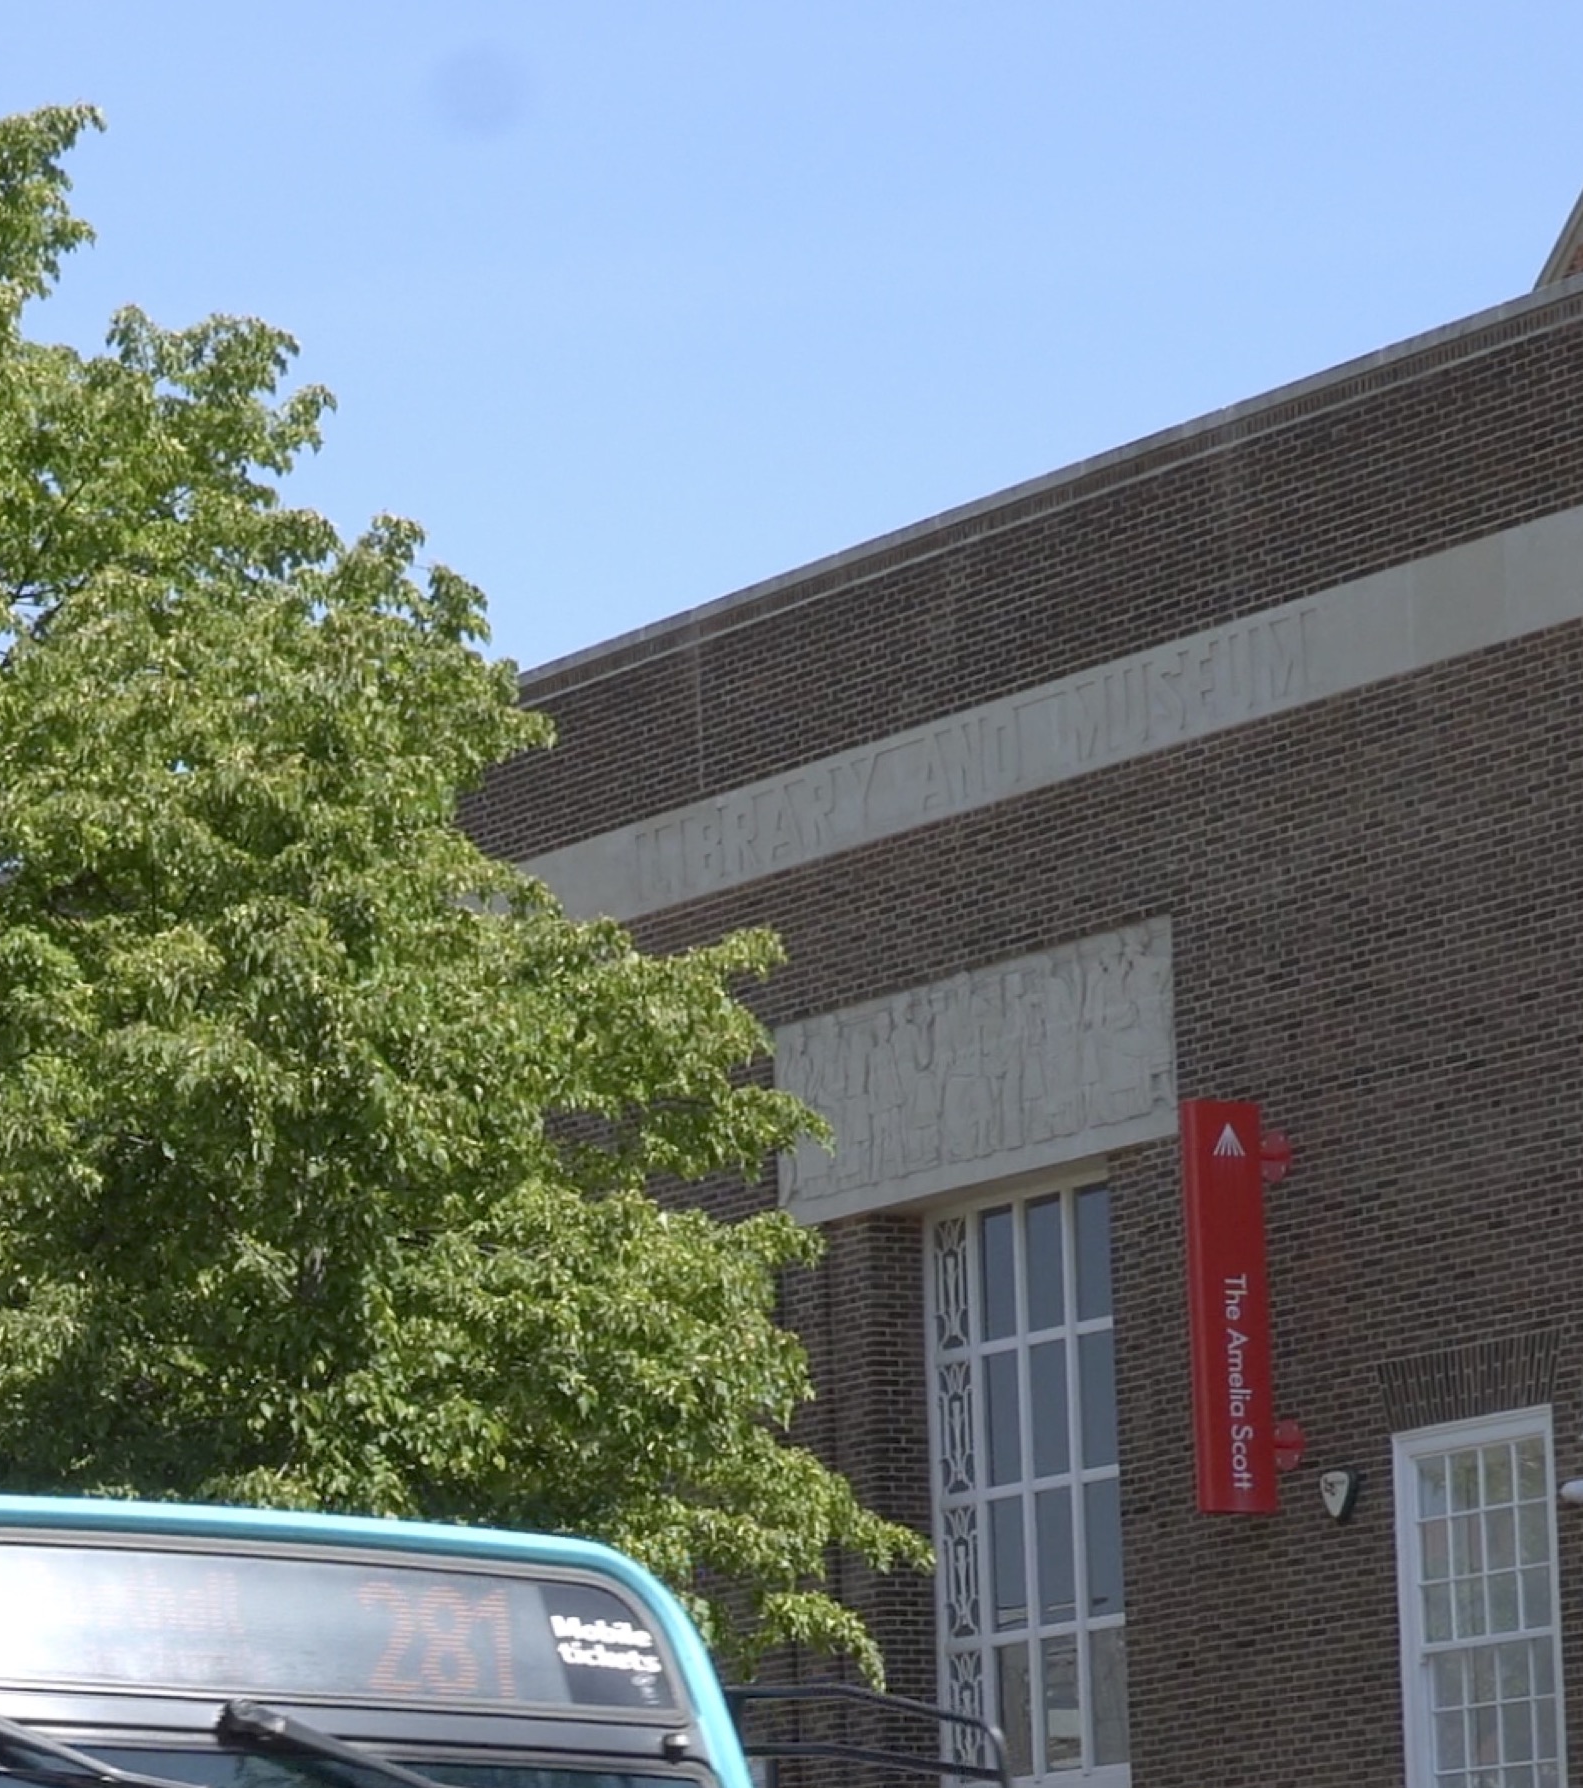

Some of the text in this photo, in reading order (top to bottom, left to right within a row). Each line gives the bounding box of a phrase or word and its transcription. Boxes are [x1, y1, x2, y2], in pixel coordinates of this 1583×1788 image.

[627, 609, 1309, 901] LIBRARY AND MUSEUM
[1224, 1273, 1254, 1490] The Amelia Scott
[356, 1581, 517, 1698] 281
[549, 1614, 653, 1648] Mobile
[557, 1640, 663, 1673] tickets
